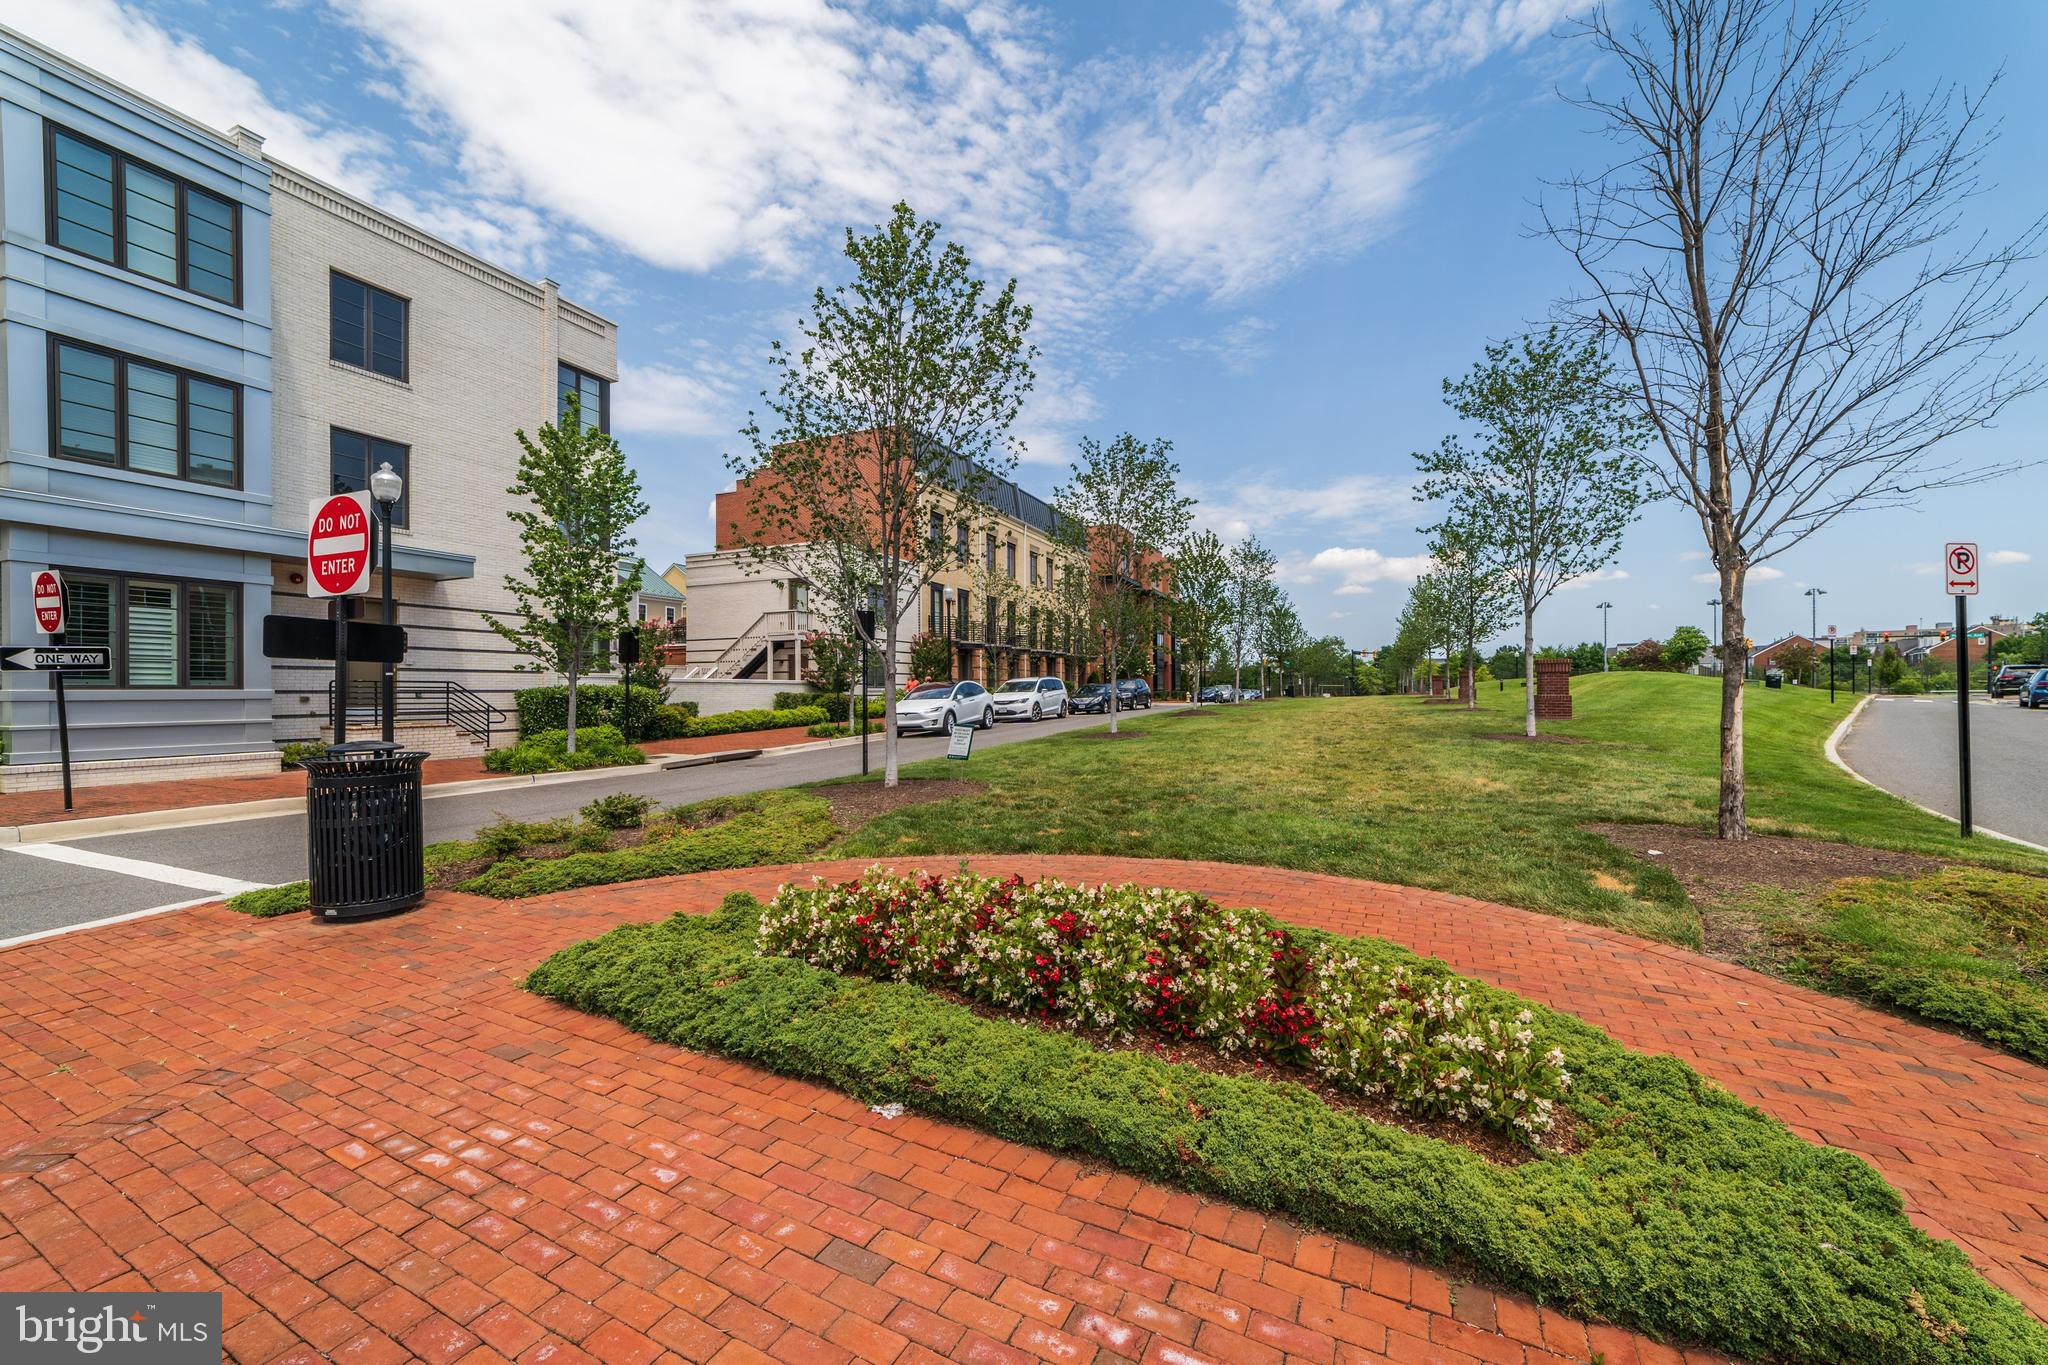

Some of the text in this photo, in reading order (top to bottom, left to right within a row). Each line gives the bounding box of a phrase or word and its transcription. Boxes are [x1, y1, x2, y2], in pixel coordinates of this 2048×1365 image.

[319, 513, 360, 533] DO NOT
[321, 558, 355, 576] ENTER
[37, 583, 56, 594] DO NOT
[41, 611, 58, 621] ENTER
[35, 654, 99, 664] ONE WAY
